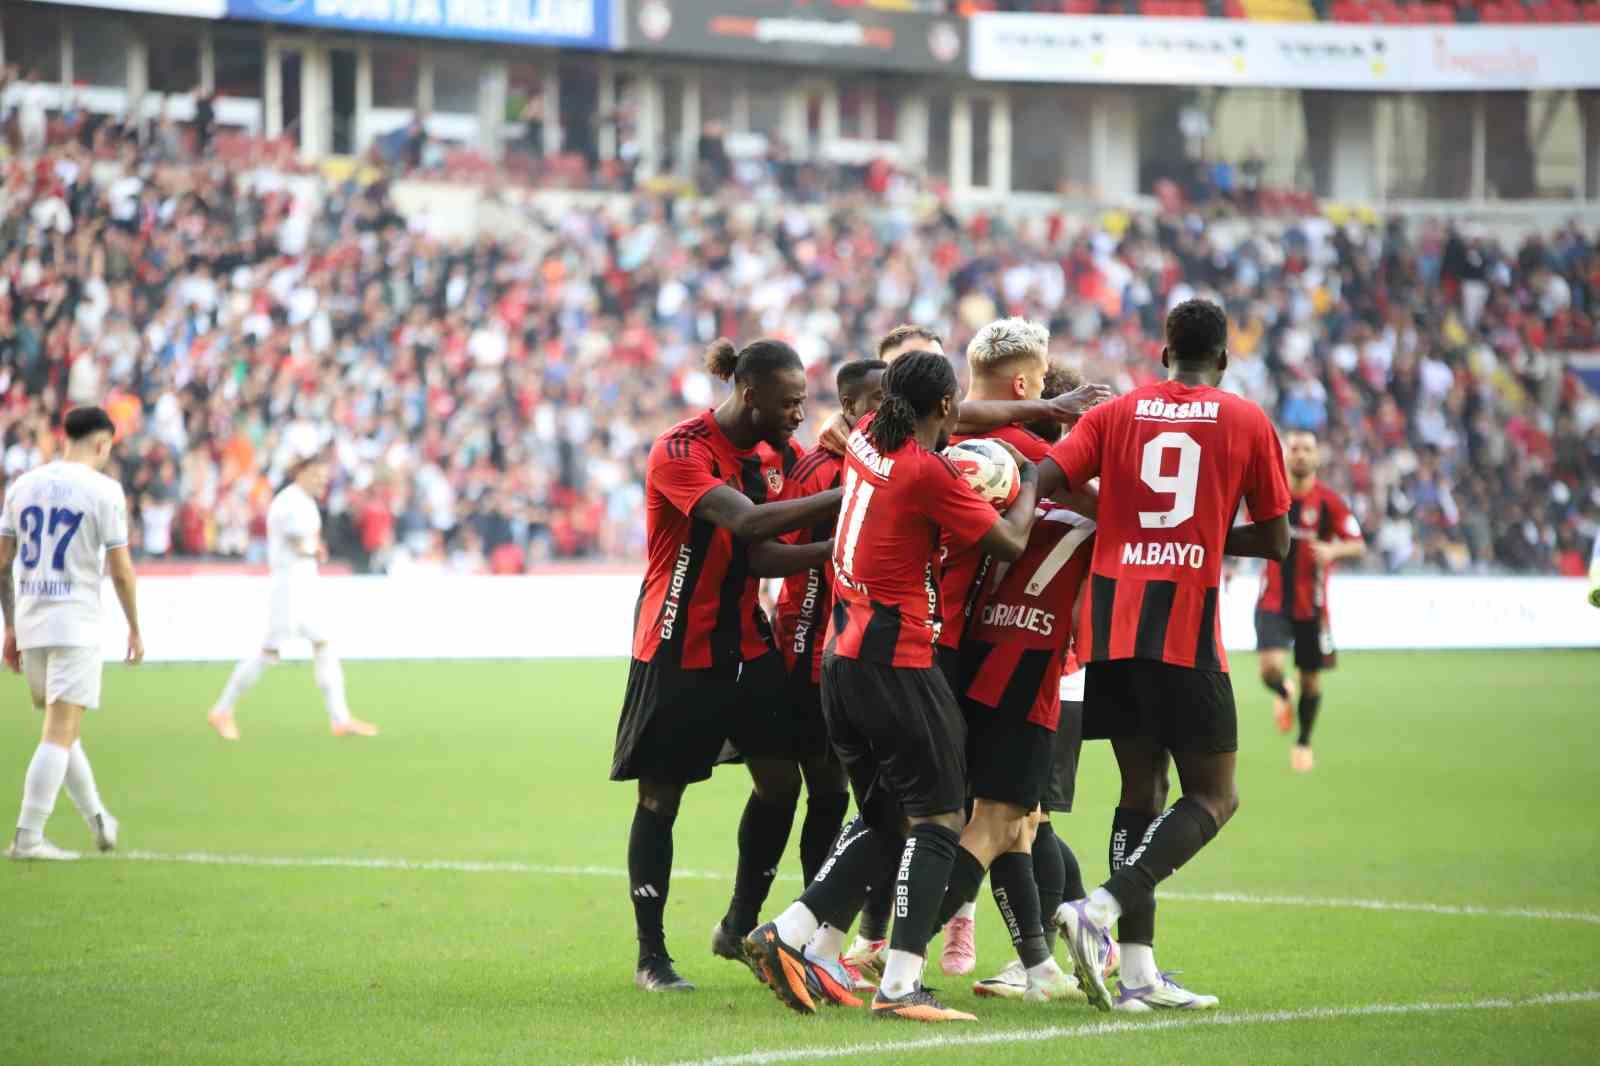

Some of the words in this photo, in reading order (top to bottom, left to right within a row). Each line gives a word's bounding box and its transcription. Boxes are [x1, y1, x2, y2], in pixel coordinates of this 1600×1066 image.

[1135, 397, 1220, 419] KÖKSAN
[1138, 432, 1202, 529] 9
[20, 505, 84, 571] 37
[832, 465, 875, 577] 11
[670, 543, 693, 599] KONUT
[1121, 541, 1205, 569] M.BAYO
[801, 567, 820, 618] KONUT
[896, 885, 909, 918] GBB
